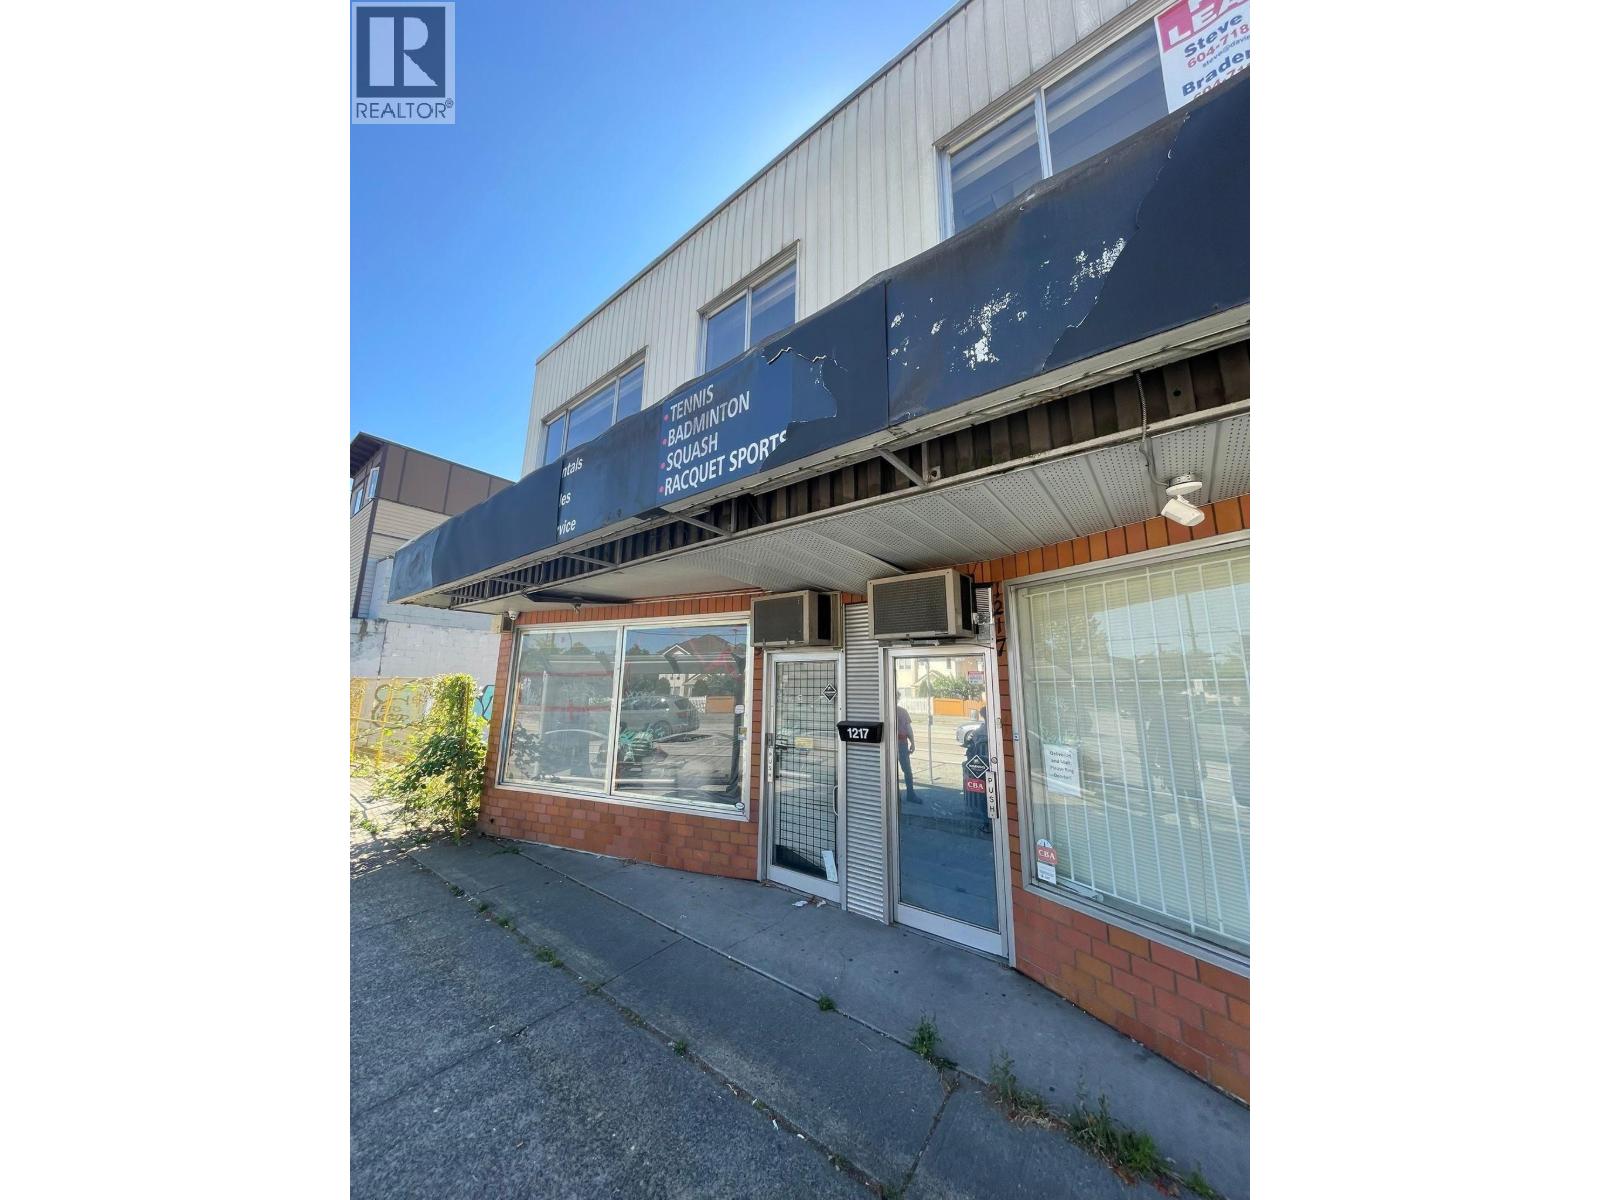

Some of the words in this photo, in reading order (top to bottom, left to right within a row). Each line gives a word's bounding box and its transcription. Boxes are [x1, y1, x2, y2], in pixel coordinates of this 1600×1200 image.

[1184, 14, 1243, 58] Steve
[667, 390, 750, 448] BADMINTON
[670, 384, 714, 422] TENNIS
[666, 432, 719, 472] SQUASH
[664, 455, 726, 497] RACQUET
[847, 727, 869, 739] 1217
[967, 781, 984, 790] CBA
[1038, 849, 1056, 861] CBA
